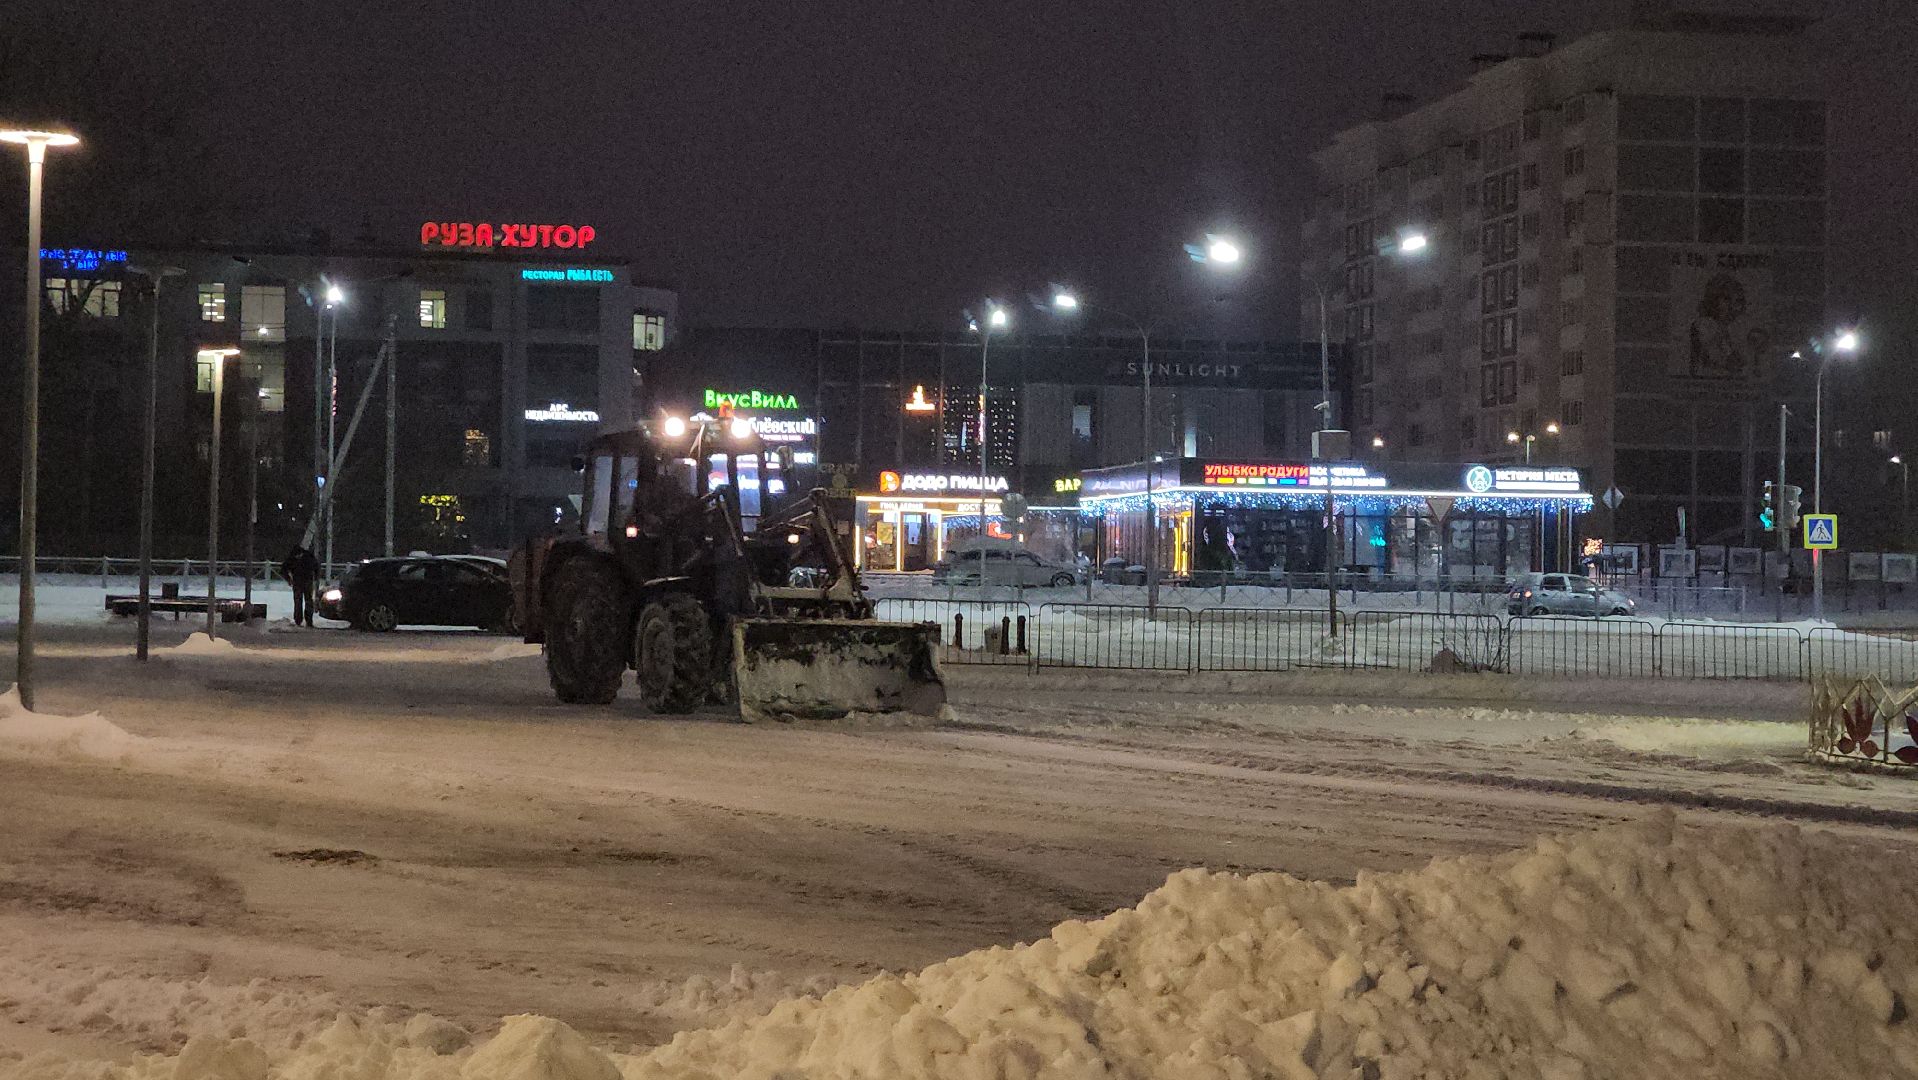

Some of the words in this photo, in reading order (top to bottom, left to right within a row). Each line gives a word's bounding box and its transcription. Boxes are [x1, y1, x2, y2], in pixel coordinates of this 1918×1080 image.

[522, 270, 565, 280] РЕСТОРАН
[567, 269, 592, 281] РЫБА
[592, 270, 614, 281] ЕСТЬ
[1127, 362, 1241, 377] SUNLIGHT
[705, 388, 799, 409] ВкусВилл
[525, 410, 600, 422] НЕДВИЖИМОСТЬ
[1496, 469, 1544, 481] ИСТОРИЯ
[1544, 470, 1580, 482] МЕСТА
[902, 474, 948, 491] ДОДО
[950, 475, 1010, 492] ПИЦЦА
